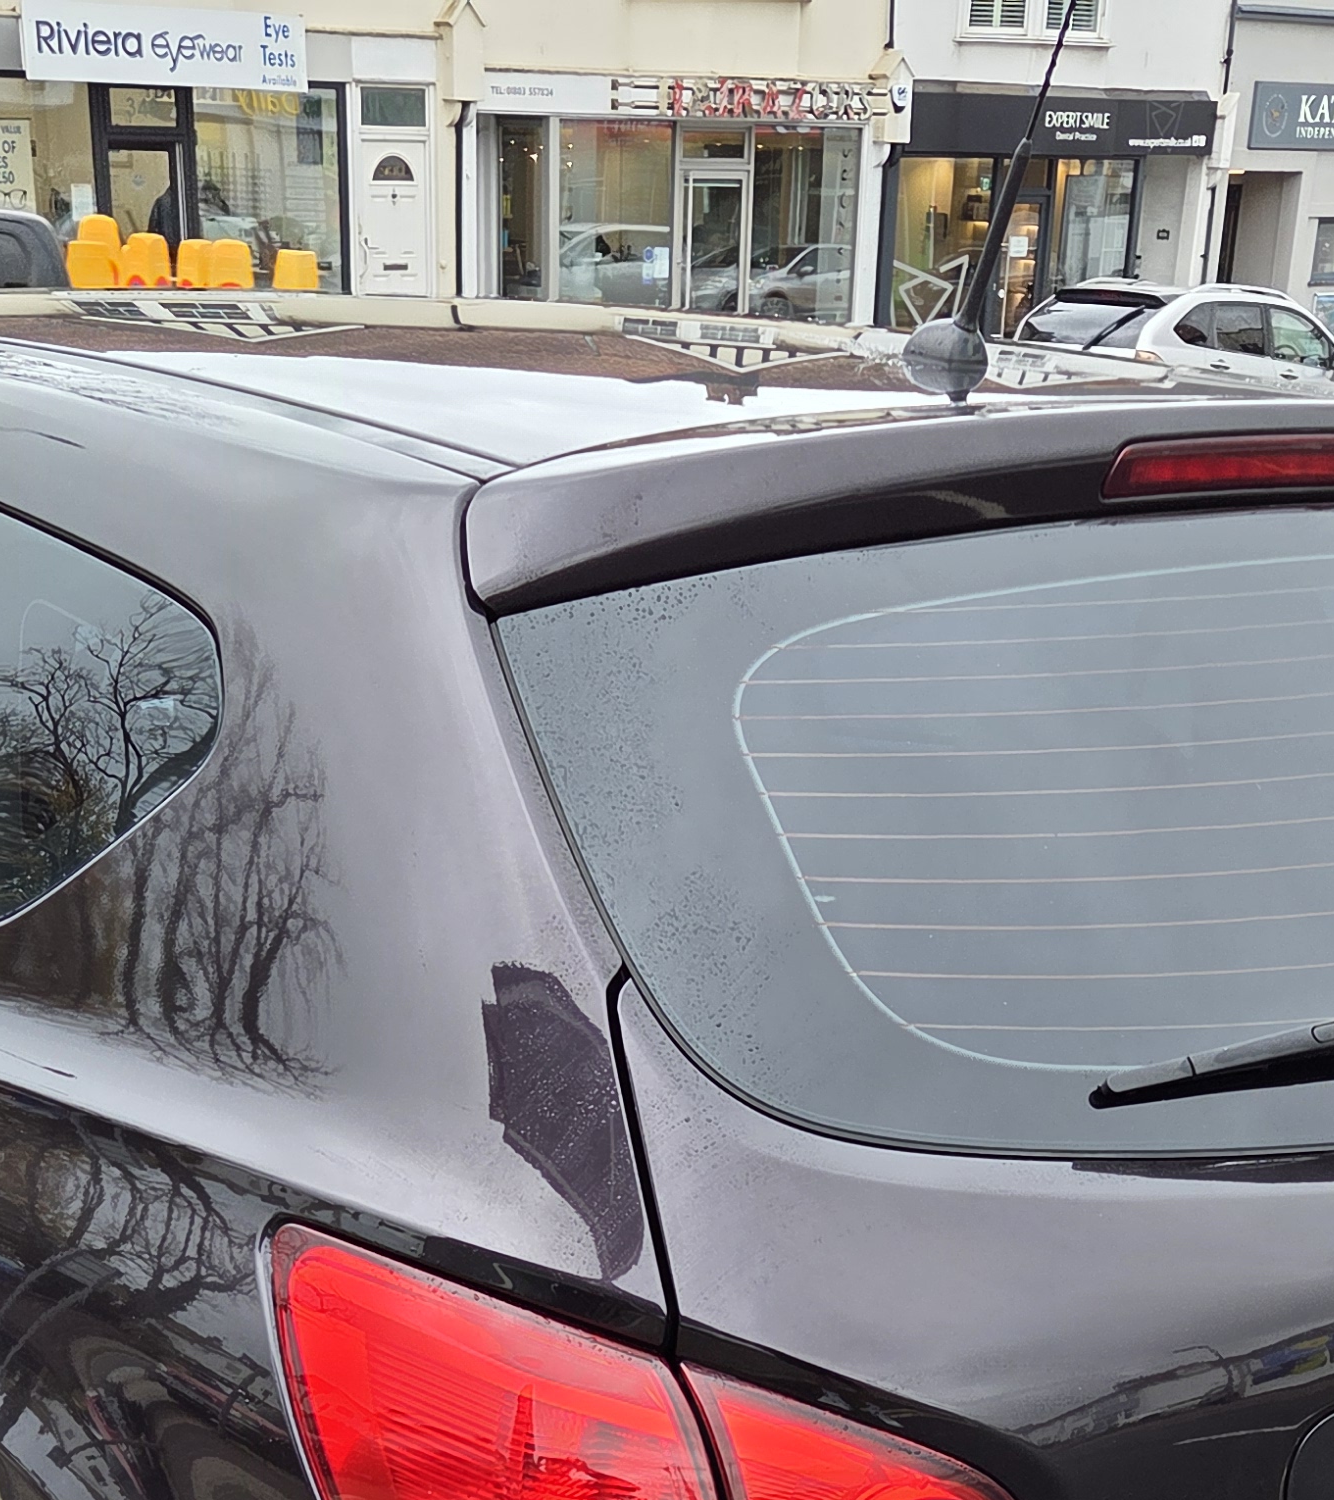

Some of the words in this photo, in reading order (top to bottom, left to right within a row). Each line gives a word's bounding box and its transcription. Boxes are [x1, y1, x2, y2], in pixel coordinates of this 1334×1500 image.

[263, 16, 291, 44] Eye
[35, 19, 144, 58] Riviera
[151, 30, 243, 72] eyewear
[260, 44, 296, 68] Tests
[262, 74, 297, 87] Available
[0, 125, 22, 135] VALUE
[1044, 111, 1081, 129] EXPERT
[1081, 112, 1111, 130] SMILE
[2, 140, 17, 154] OF
